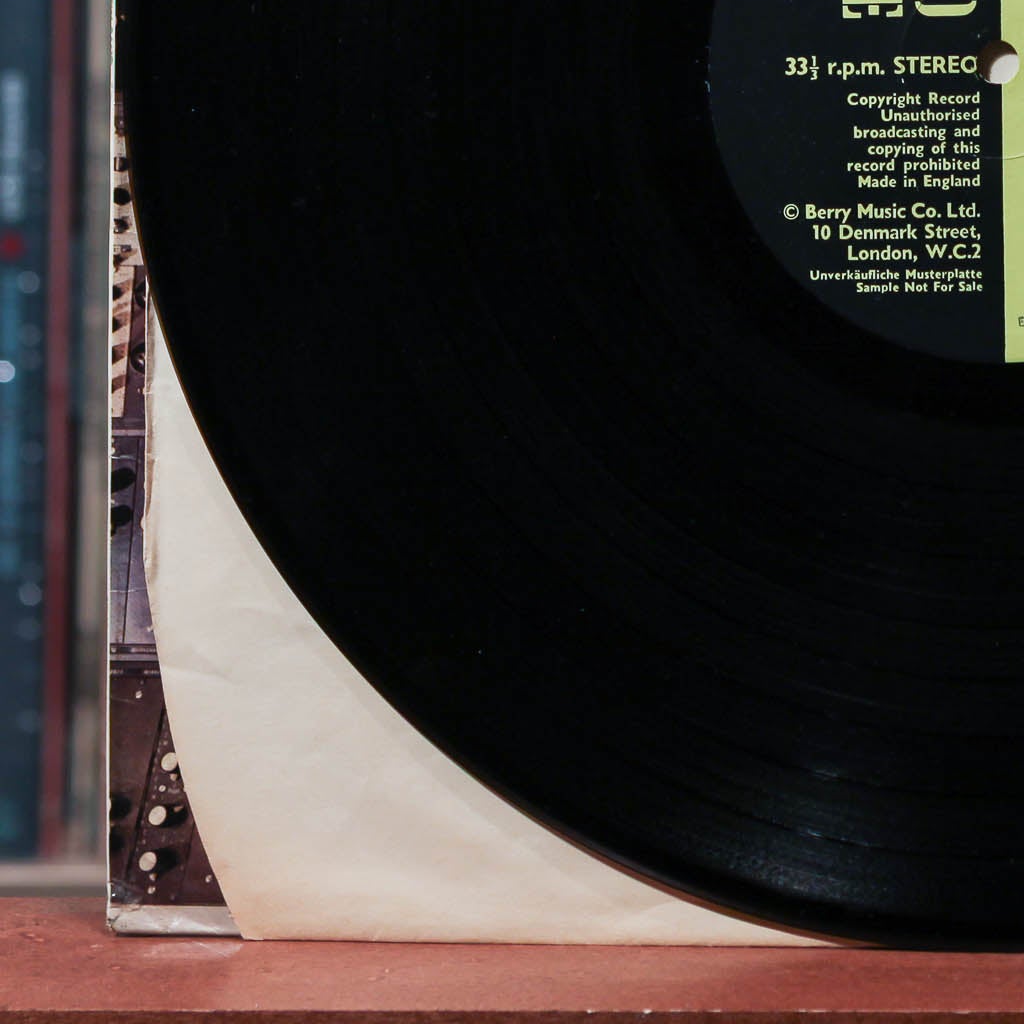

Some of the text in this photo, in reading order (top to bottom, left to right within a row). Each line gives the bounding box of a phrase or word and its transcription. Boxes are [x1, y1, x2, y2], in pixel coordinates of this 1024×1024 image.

[827, 60, 886, 81] r.p.m.
[893, 55, 978, 75] STEREO
[847, 91, 981, 109] Copyright Record
[880, 108, 980, 122] Unauthorised
[853, 124, 981, 141] broadcasting and
[867, 141, 981, 158] copying of this
[847, 157, 981, 174] record prohibited
[858, 174, 981, 190] Made in England
[805, 203, 852, 224] Berry
[857, 202, 907, 219] Music
[911, 202, 942, 219] Co.
[947, 202, 981, 219] Ltd.
[812, 223, 982, 241] 10 Denmark Street,
[847, 244, 982, 263] London, W.C.2
[809, 268, 983, 282] Unverkäufliche Musterplatte
[856, 281, 984, 294] Sample Not For Sale
